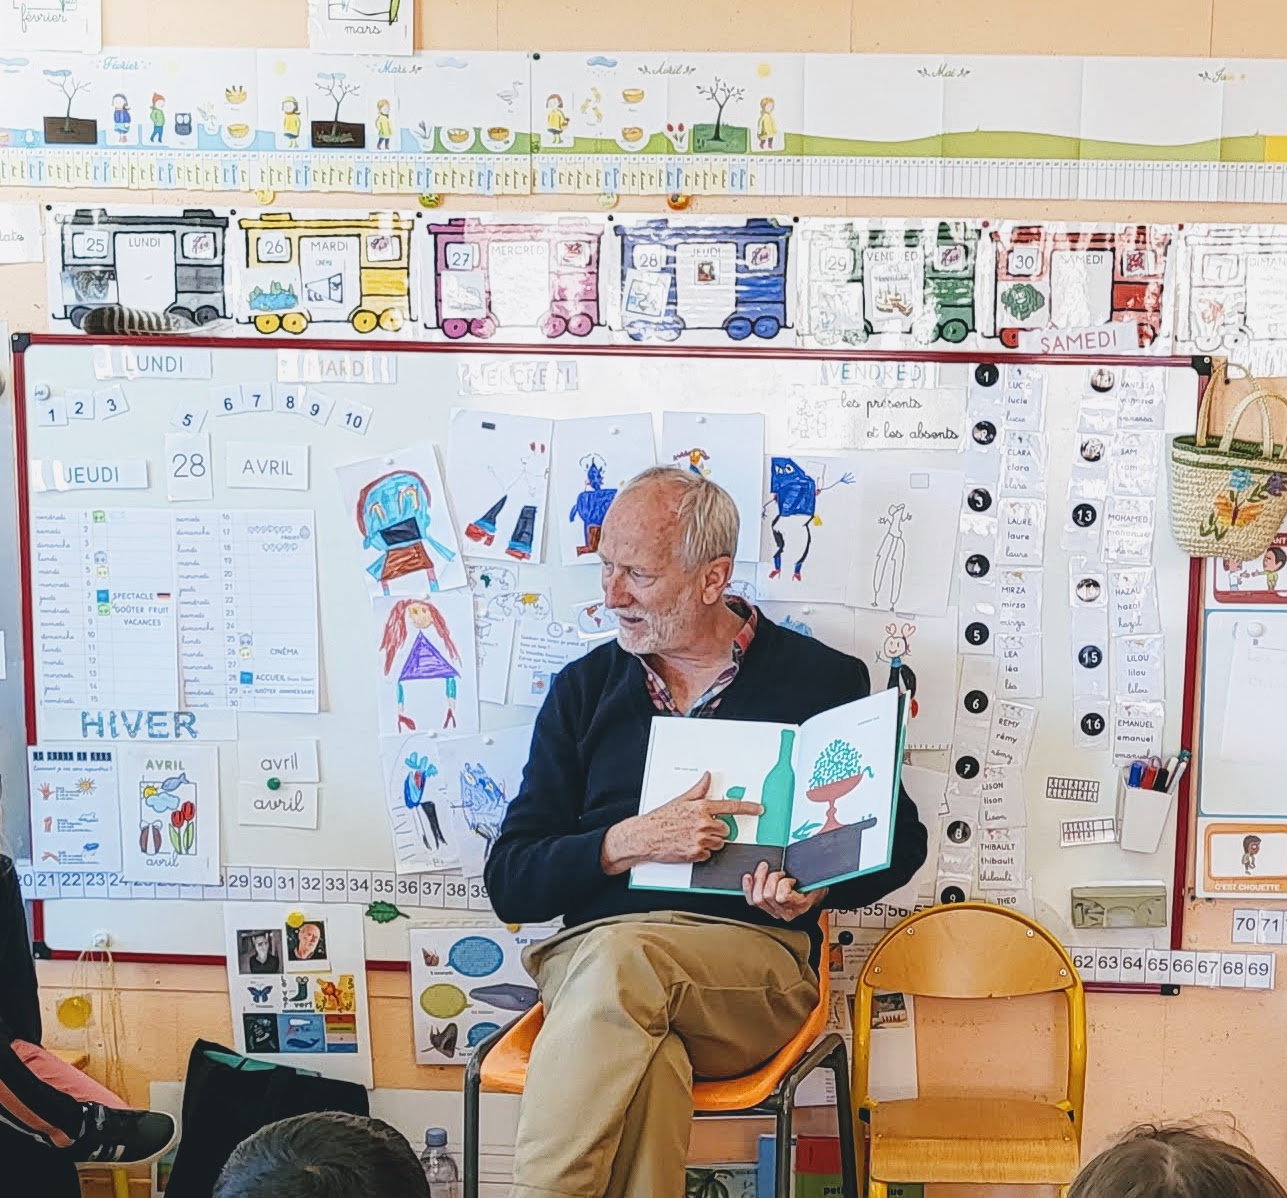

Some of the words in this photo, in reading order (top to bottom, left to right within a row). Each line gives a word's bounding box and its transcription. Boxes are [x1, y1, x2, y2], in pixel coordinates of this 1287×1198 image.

[20, 4, 69, 24] février
[344, 23, 383, 36] mars
[377, 62, 409, 75] Mars
[651, 62, 683, 76] Avril
[931, 63, 955, 78] Mai
[86, 237, 107, 253] 25
[128, 238, 161, 250] LUNDI
[265, 240, 284, 256] 26
[311, 241, 349, 253] MARDI
[491, 244, 546, 256] MERCREDI
[452, 252, 470, 267] 27
[691, 246, 721, 258] JEUDI
[639, 253, 658, 268] 28
[828, 254, 847, 272] 29
[1015, 252, 1034, 271] 30
[1039, 331, 1119, 355] SAMEDI
[123, 355, 185, 374] LUNDI
[74, 401, 84, 415] 2
[106, 397, 118, 414] 3
[223, 397, 234, 412] 6
[253, 393, 262, 408] 7
[285, 395, 296, 411] 8
[841, 395, 859, 410] les
[866, 397, 923, 419] présents
[47, 407, 56, 423] 1
[309, 403, 321, 418] 9
[181, 413, 193, 428] 5
[343, 411, 364, 430] 10
[866, 427, 880, 440] et
[884, 427, 905, 440] les
[909, 426, 960, 441] absents
[171, 452, 206, 479] 28
[242, 459, 294, 477] AVRIL
[1007, 463, 1030, 473] clara
[62, 465, 120, 485] JEUDI
[1007, 517, 1032, 526] LAURE
[1077, 509, 1093, 522] 13
[1108, 514, 1149, 524] MOHAMED
[1007, 532, 1030, 541] laure
[1001, 586, 1026, 595] MIRZA
[1082, 651, 1099, 664] 15
[1127, 653, 1149, 663] LILOU
[81, 709, 198, 741] HIVER
[1085, 719, 1101, 731] 16
[1117, 718, 1155, 730] EMANUEL
[1117, 734, 1154, 744] emanuel
[145, 759, 186, 772] AVRIL
[261, 751, 300, 772] avril
[982, 781, 1004, 791] LISON
[252, 790, 305, 813] avril
[980, 843, 1016, 852] THIBAULT
[146, 854, 179, 868] avril
[981, 857, 1015, 865] thibault
[38, 873, 56, 888] 21
[61, 873, 81, 888] 22
[85, 874, 105, 888] 23
[229, 875, 249, 889] 29
[253, 876, 273, 889] 30
[277, 876, 296, 890] 31
[301, 877, 321, 891] 32
[325, 878, 346, 892] 33
[349, 879, 369, 893] 34
[373, 879, 394, 893] 35
[397, 881, 418, 896] 36
[422, 881, 442, 896] 37
[446, 883, 466, 898] 38
[470, 884, 490, 899] 39
[1239, 883, 1280, 892] CHOUETTE
[863, 903, 884, 917] 55
[888, 905, 909, 918] 56
[1236, 917, 1257, 932] 70
[1261, 918, 1281, 933] 71
[1073, 955, 1093, 971] 62
[1098, 956, 1118, 971] 63
[1122, 956, 1143, 972] 64
[1148, 957, 1168, 973] 65
[1172, 959, 1193, 974] 66
[1197, 960, 1218, 975] 67
[1222, 961, 1243, 976] 68
[1248, 962, 1269, 978] 69
